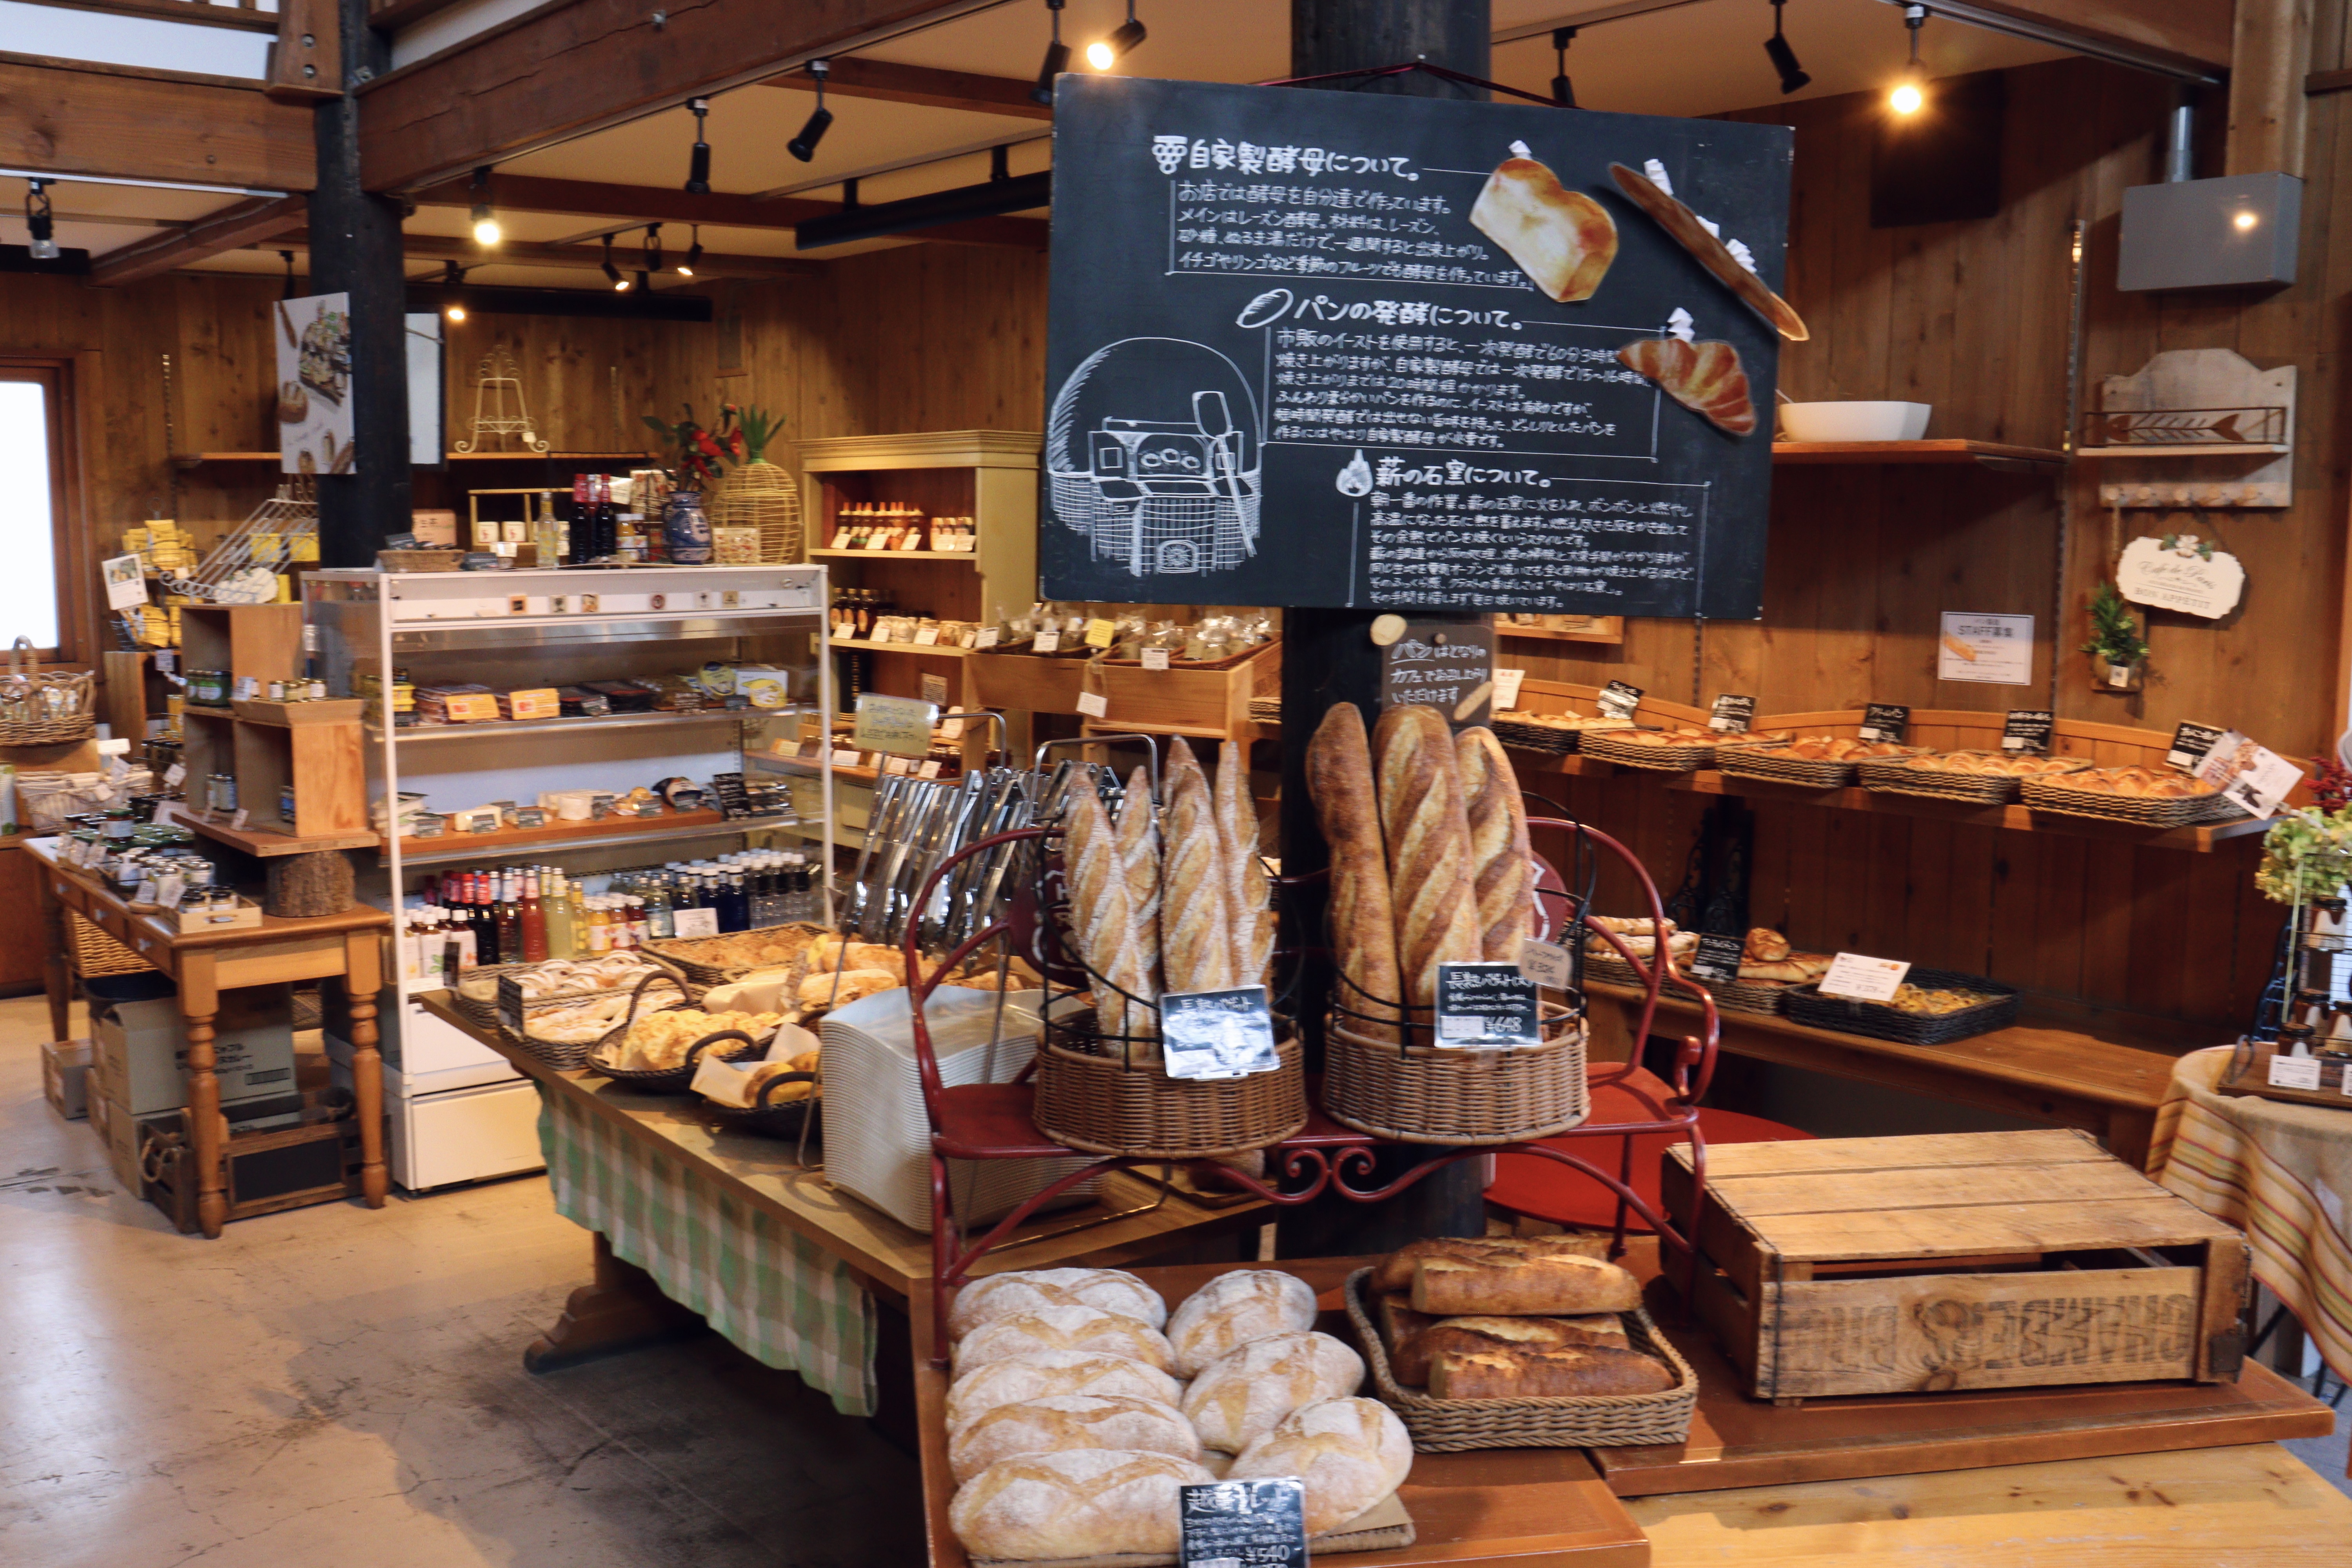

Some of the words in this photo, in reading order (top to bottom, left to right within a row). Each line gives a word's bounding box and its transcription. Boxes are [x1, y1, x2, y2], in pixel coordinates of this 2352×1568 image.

[1189, 138, 1419, 181] 自家製酵母について。
[1178, 179, 1451, 214] お店では酵母を自分達で作っています。
[1177, 207, 1440, 235] メインはレーズン酵母。材料は、レーズン、
[1177, 226, 1489, 260] 砂糖、ぬるま湯だけで、一週間すると出来上がり。
[1178, 251, 1528, 287] イチゴやリンゴなど季節のフルーツでも酵母を作っています。
[1294, 295, 1523, 330] パンの発酵について。
[1375, 456, 1551, 488] 薪の石窯について。
[1370, 529, 1590, 547] その余熱でパンを焼くというスタイルです。
[2162, 593, 2211, 609] APPETIT
[1392, 686, 1460, 705] いただけます
[1245, 1544, 1290, 1563] ¥540
